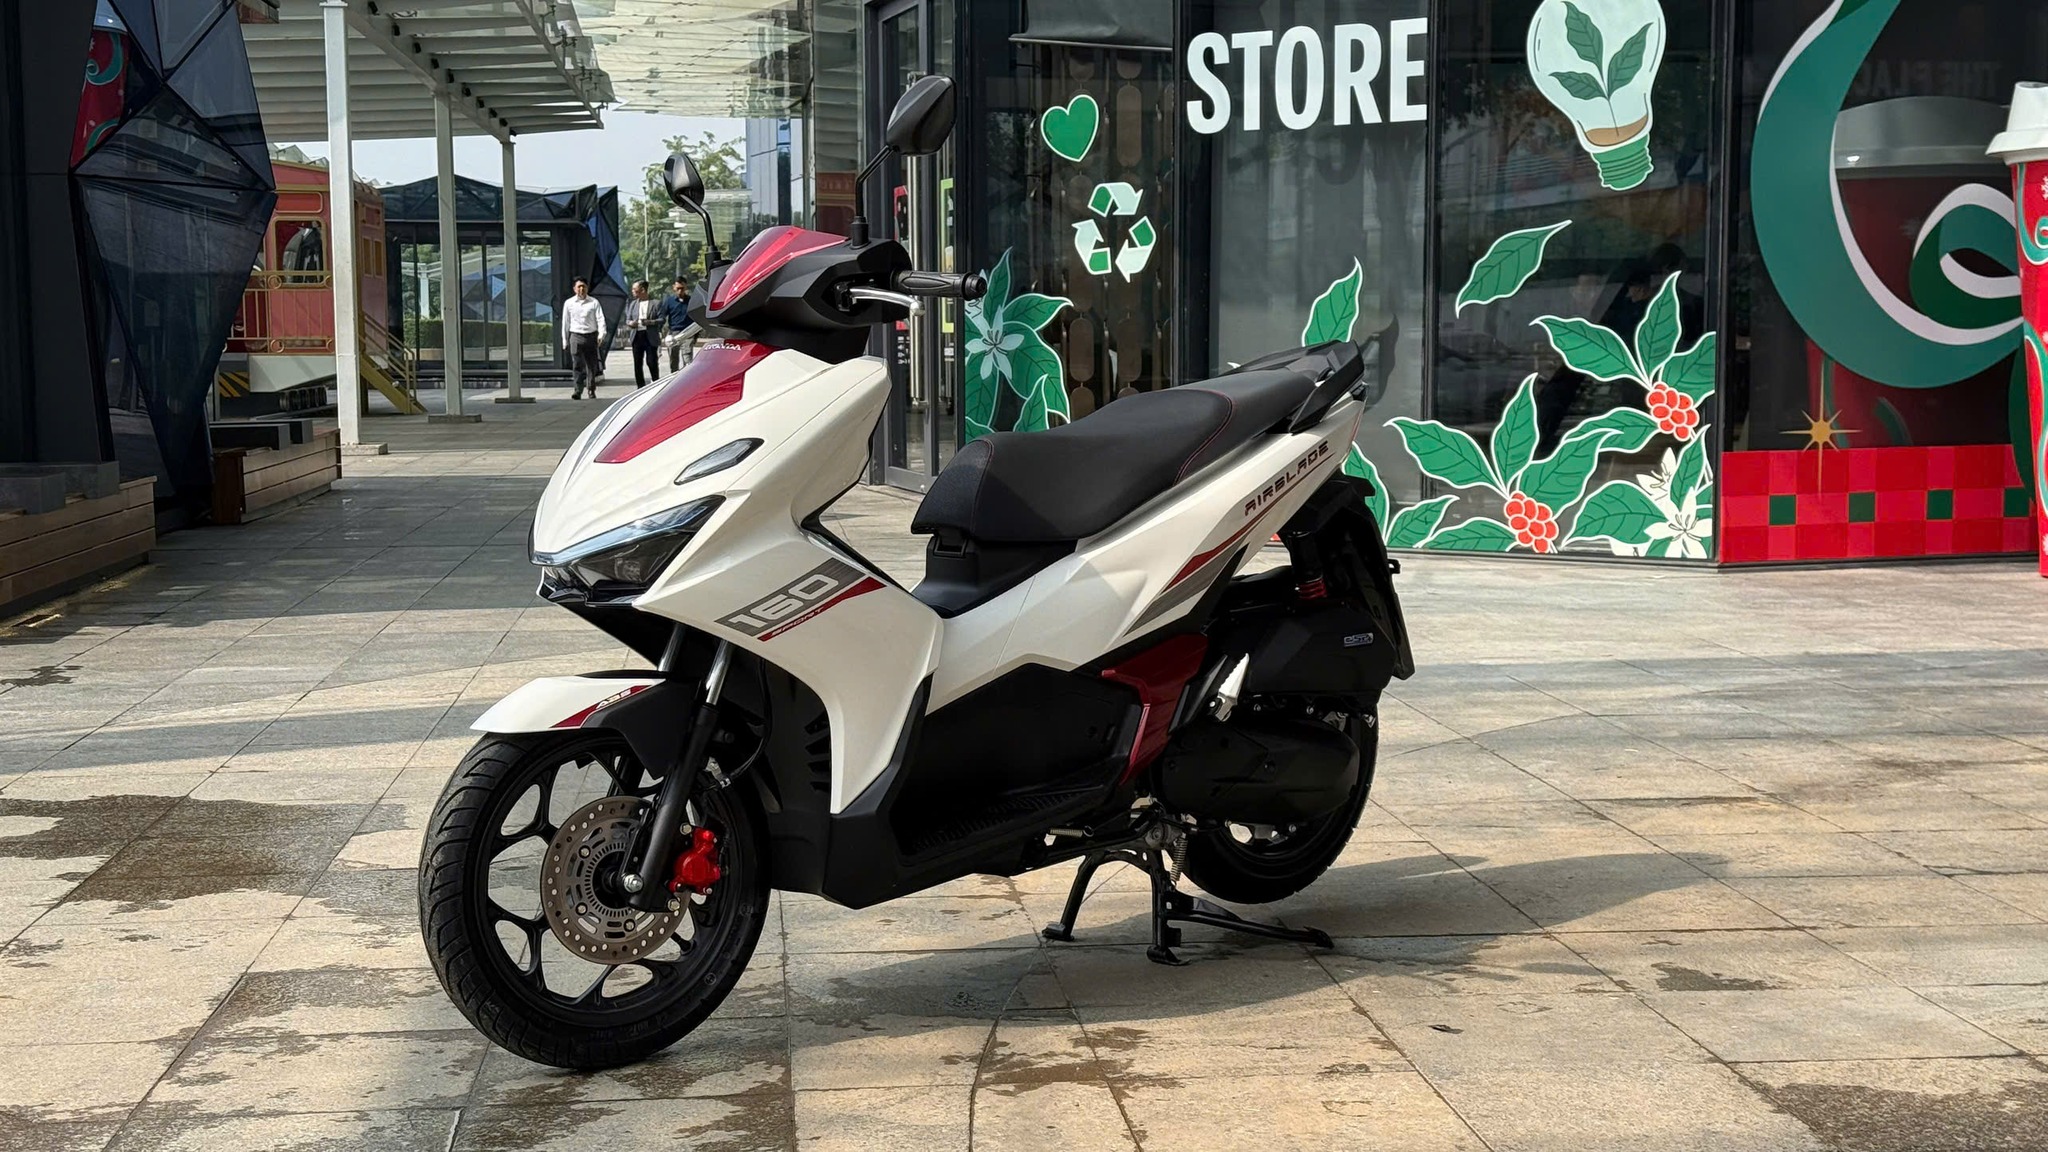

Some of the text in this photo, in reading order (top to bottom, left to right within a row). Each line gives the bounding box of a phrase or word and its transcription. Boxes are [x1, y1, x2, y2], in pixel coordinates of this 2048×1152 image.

[1187, 17, 1428, 135] STORE
[728, 574, 839, 628] 160
[595, 689, 631, 709] ABS
